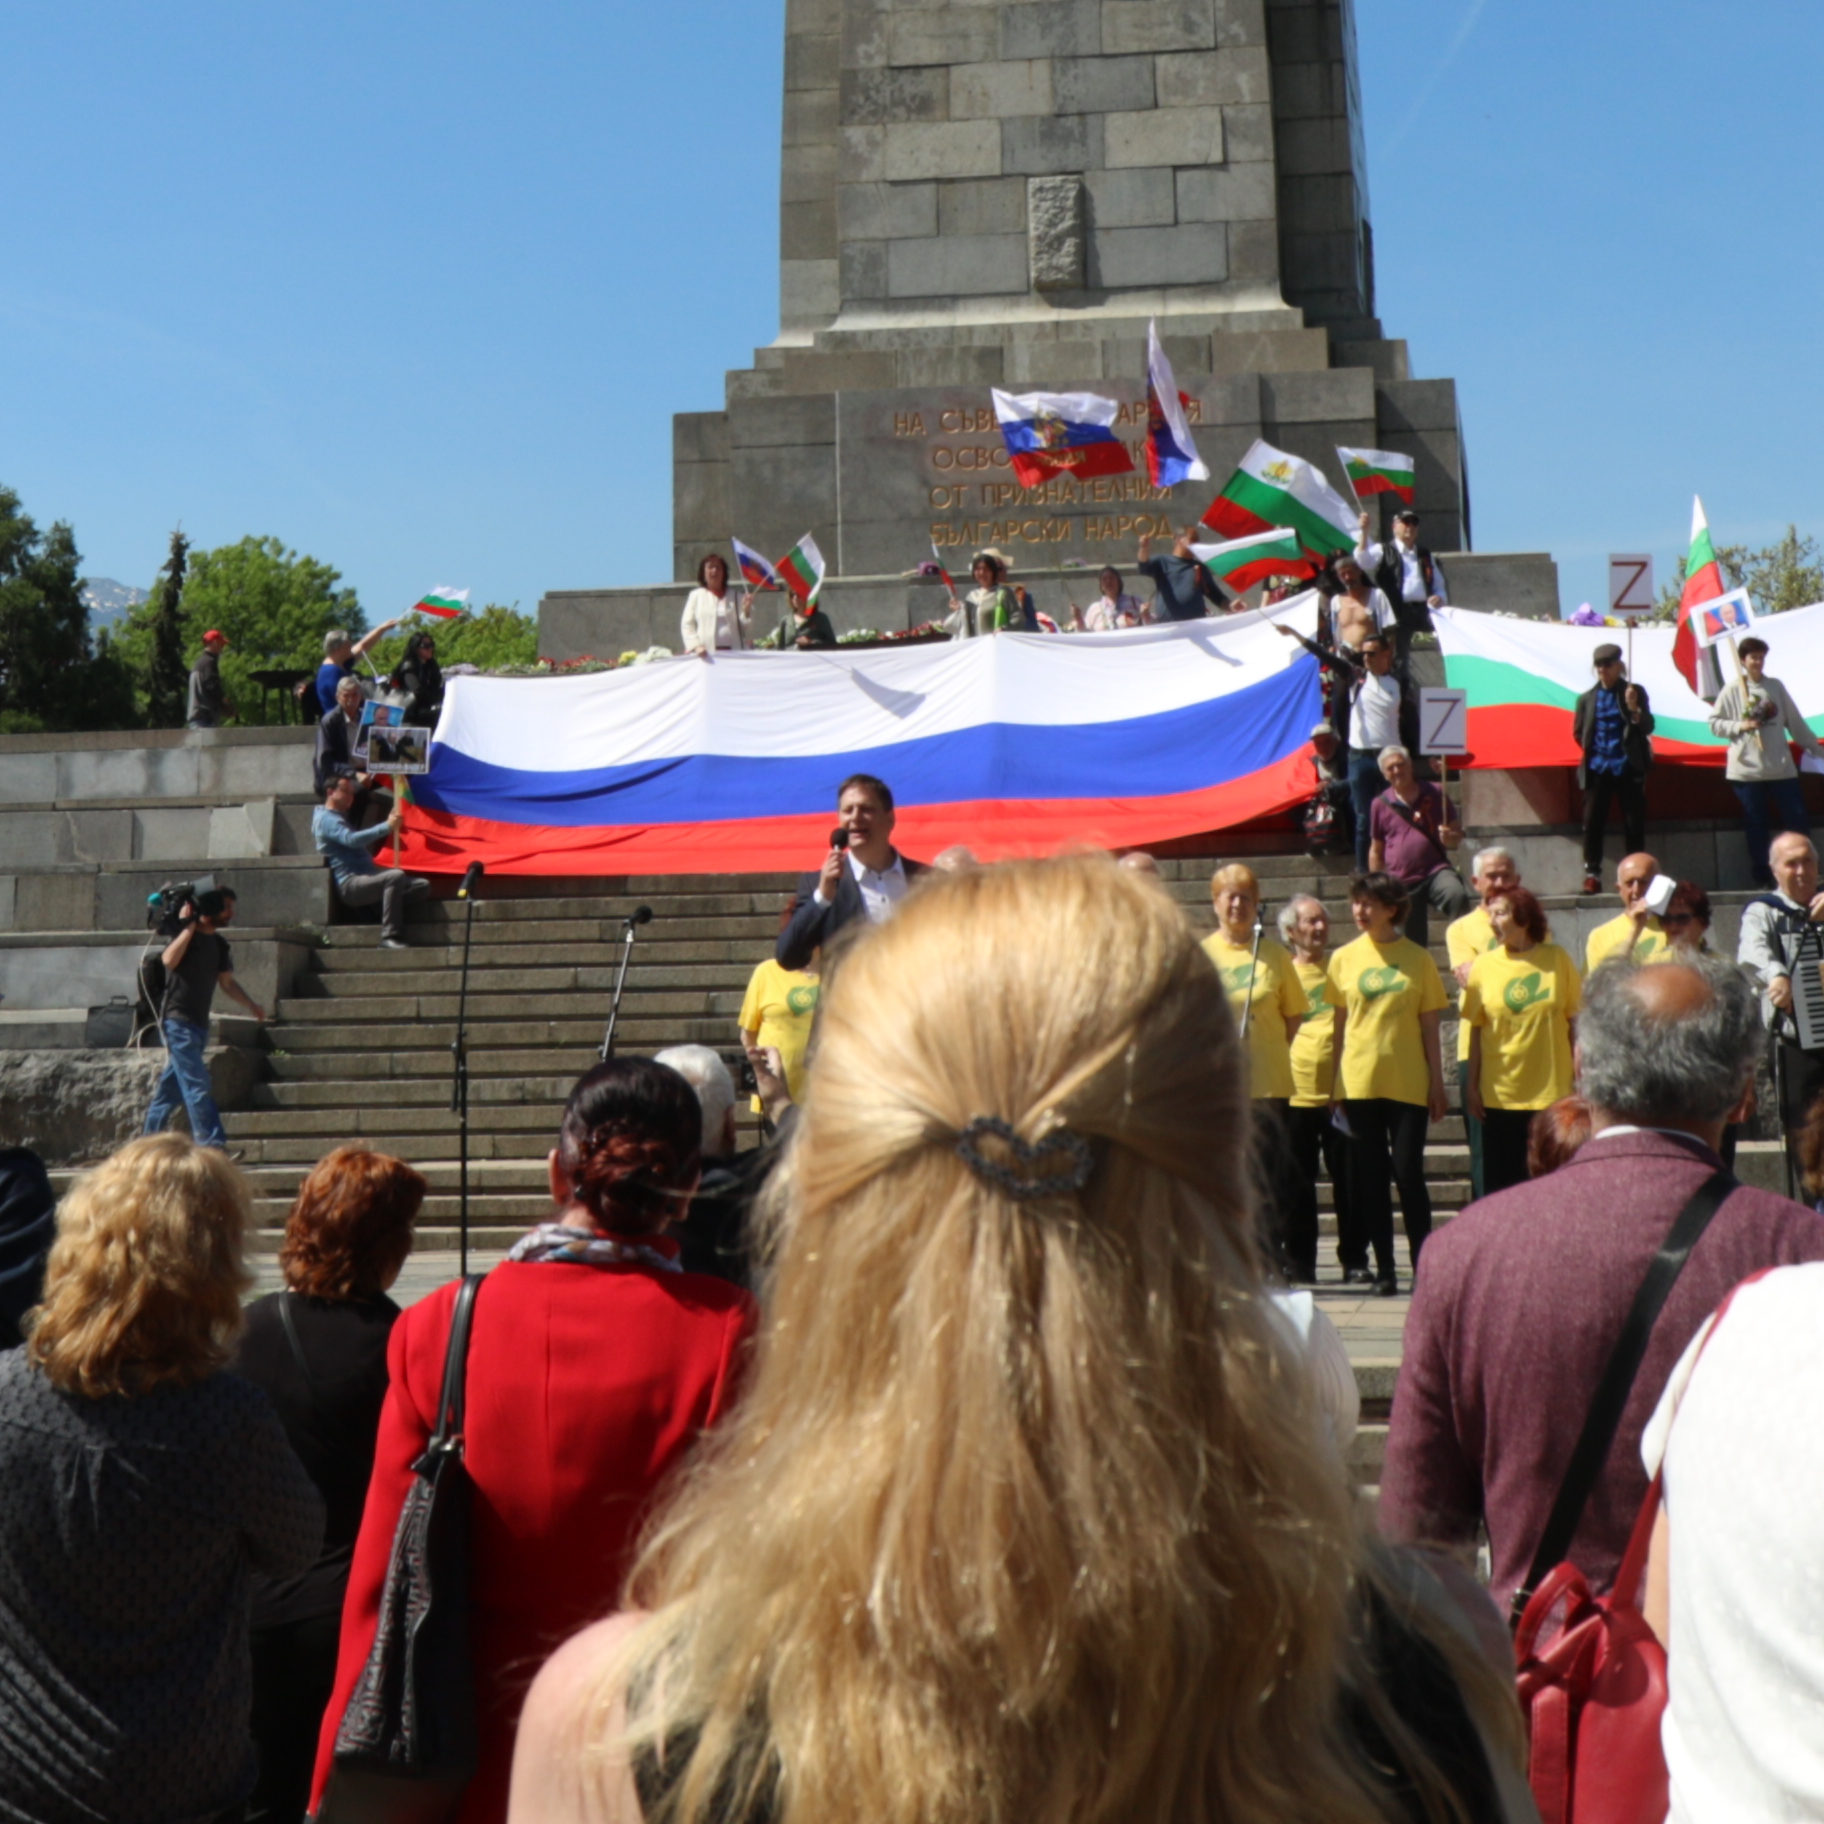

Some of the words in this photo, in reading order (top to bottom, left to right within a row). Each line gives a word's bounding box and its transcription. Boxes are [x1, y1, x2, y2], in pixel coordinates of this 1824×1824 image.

[893, 412, 926, 436] НА
[1117, 399, 1202, 425] АРЯ
[929, 484, 968, 509] ОТ
[981, 477, 1172, 507] ПРИЗНАТЕЛНИЯ
[930, 518, 1071, 546] БЪЛГАРСКИ
[1084, 514, 1174, 541] НАРОД
[1611, 561, 1651, 609] Z
[1426, 697, 1464, 749] Z
